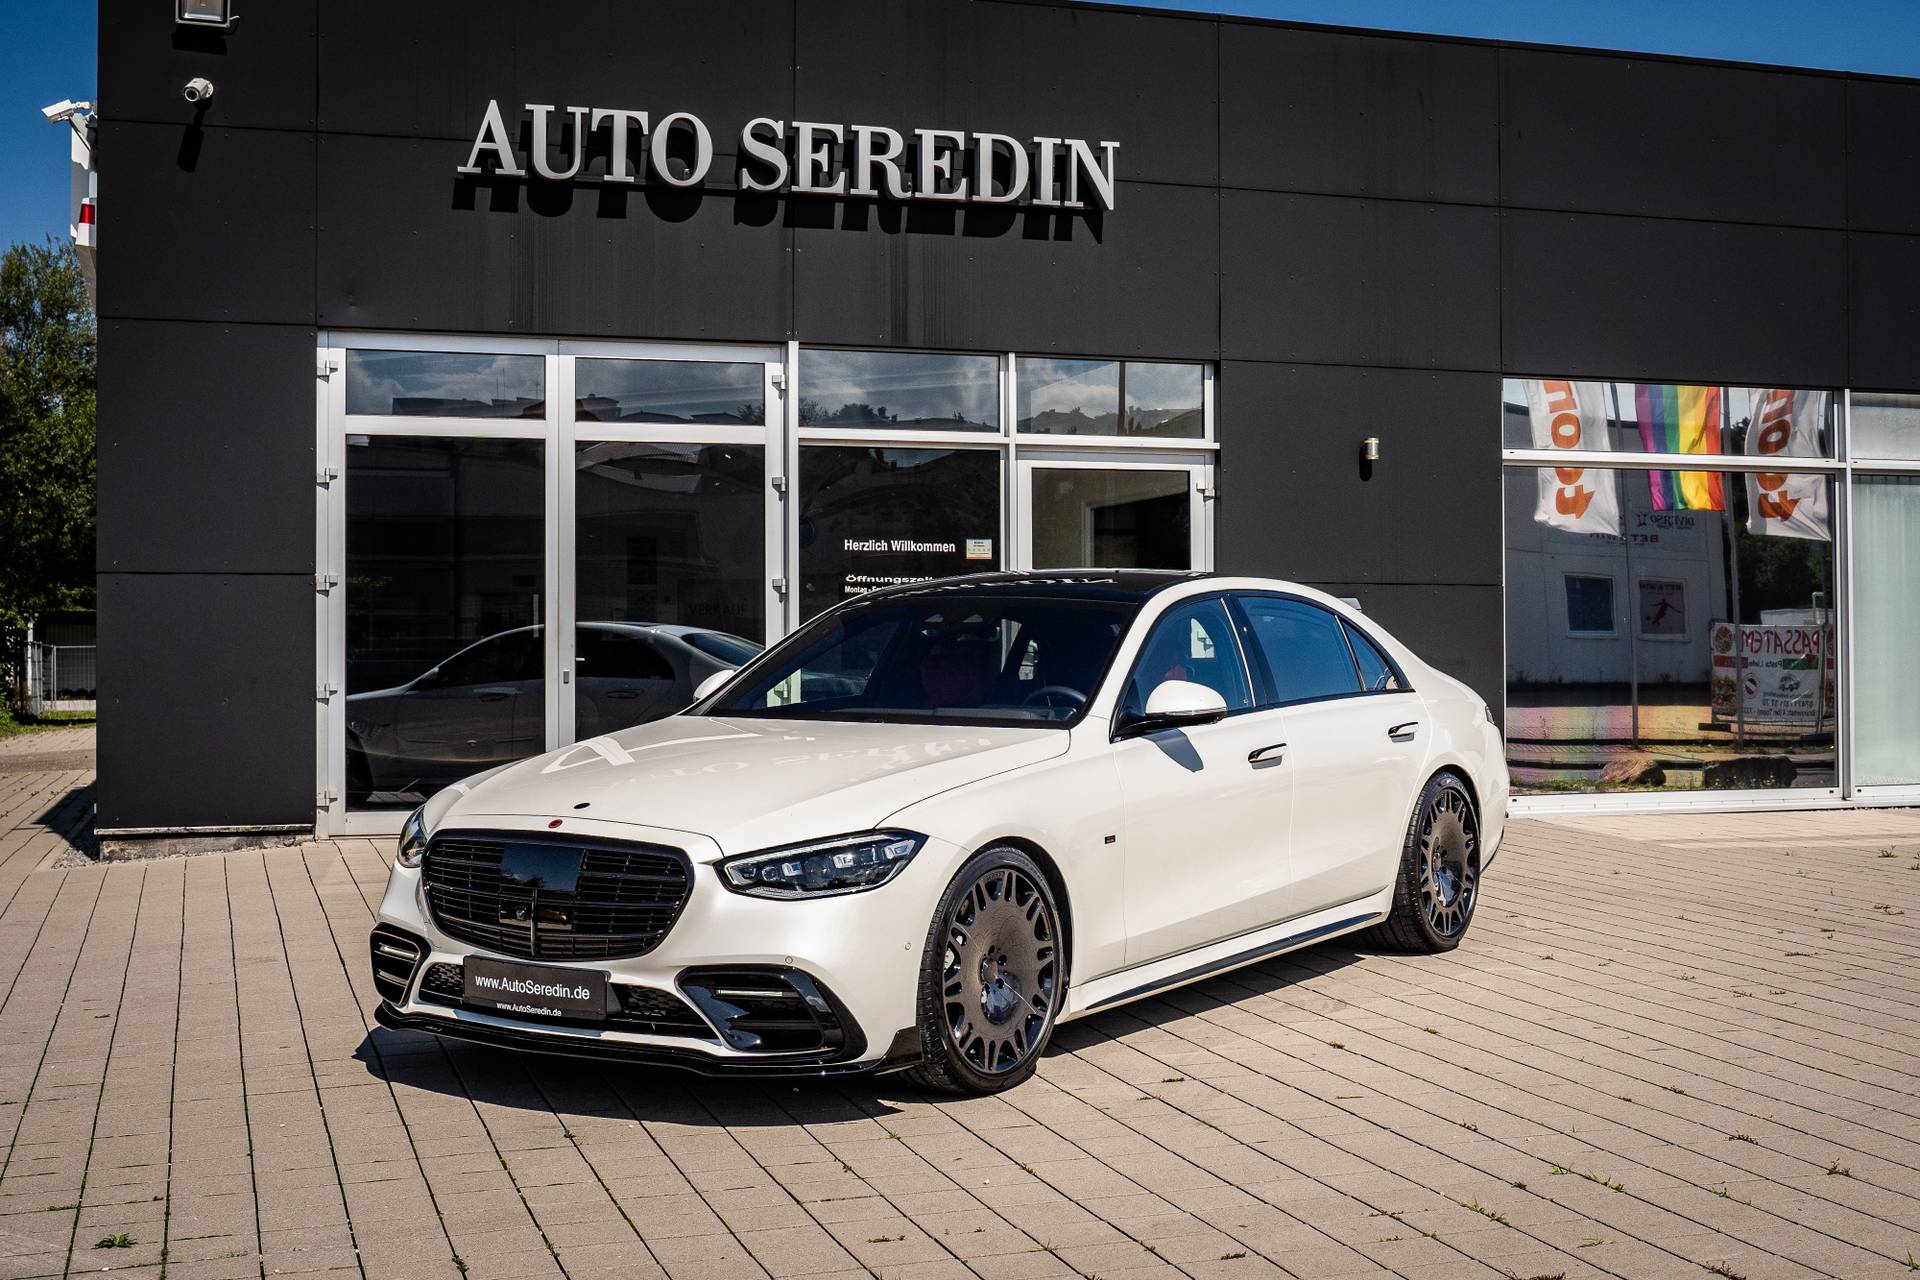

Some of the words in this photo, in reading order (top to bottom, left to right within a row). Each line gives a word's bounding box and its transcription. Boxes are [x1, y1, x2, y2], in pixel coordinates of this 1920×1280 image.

[457, 99, 713, 187] AUTO
[740, 117, 1120, 211] SEREDIN
[844, 539, 888, 552] Herzlich
[890, 540, 956, 553] Willkommen
[844, 585, 868, 594] Montag
[474, 974, 590, 1001] www.AutoSeredin.de
[496, 1001, 562, 1017] www.AutoSeredin.de
